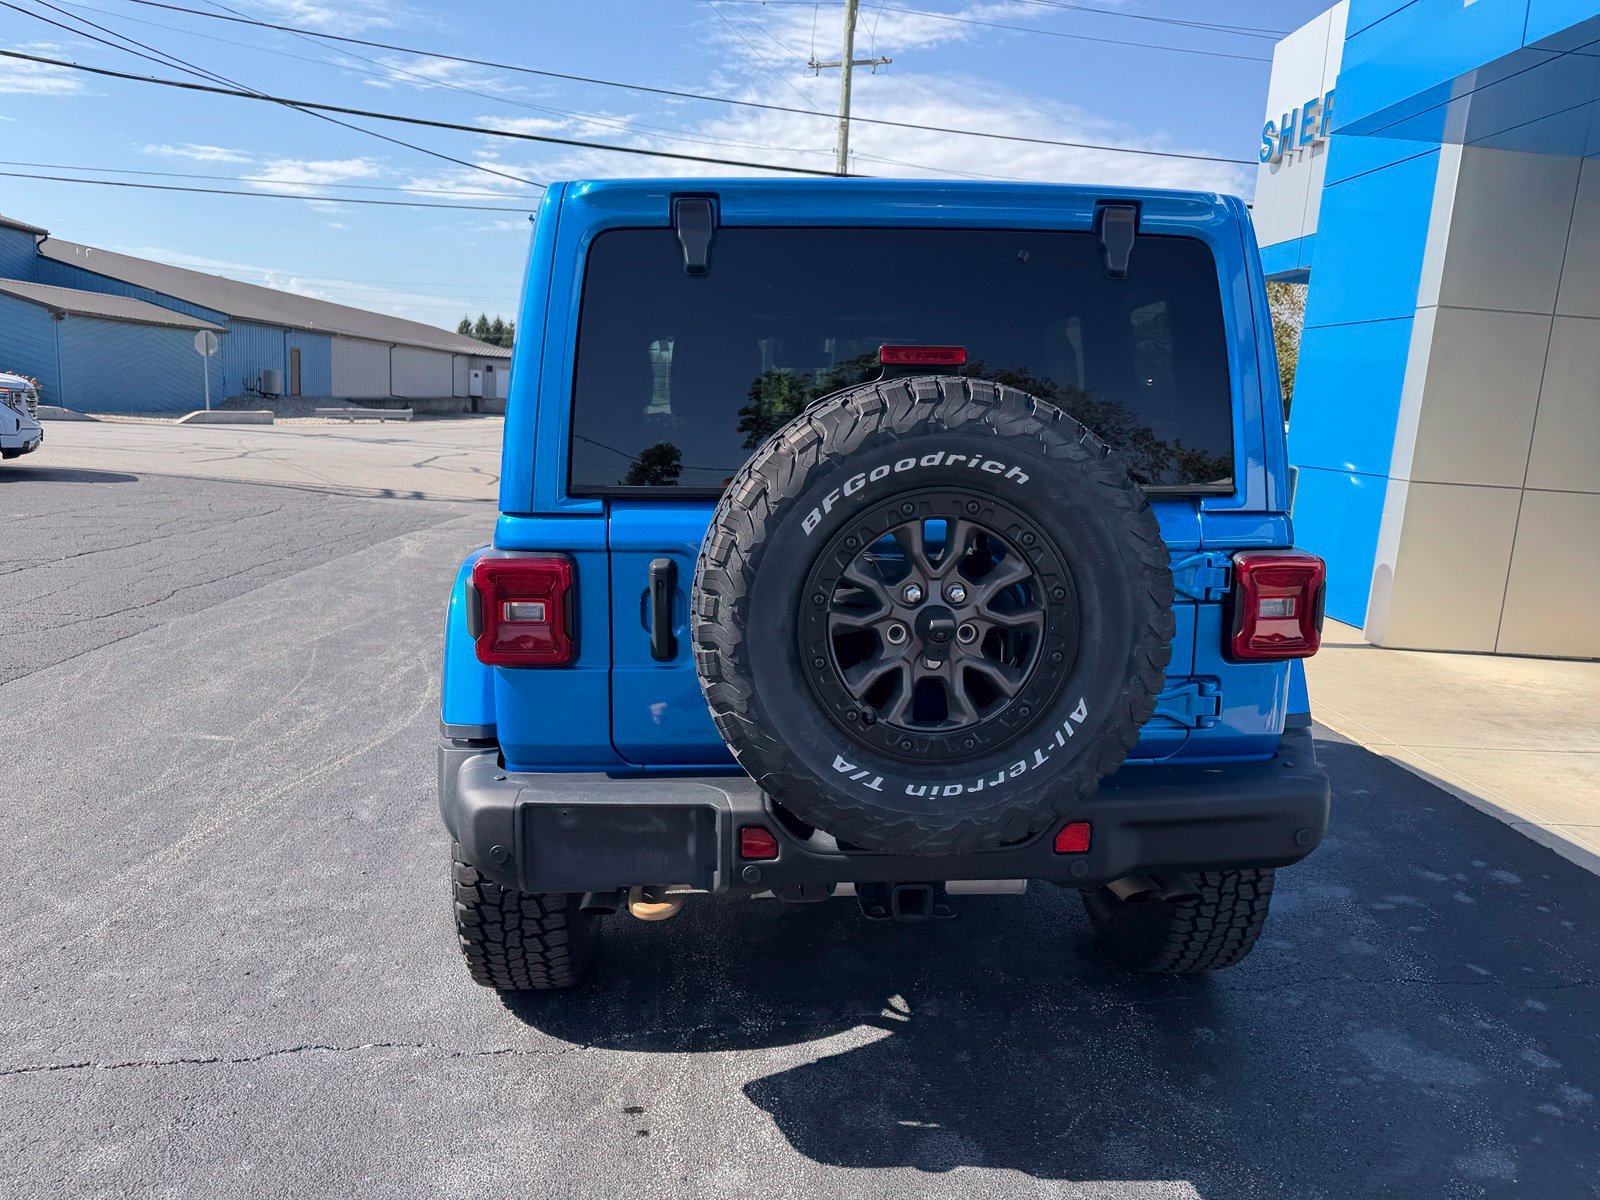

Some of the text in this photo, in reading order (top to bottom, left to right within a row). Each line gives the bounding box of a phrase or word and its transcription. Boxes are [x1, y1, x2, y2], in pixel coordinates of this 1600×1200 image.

[801, 451, 1030, 536] BFGoodrich
[832, 697, 1088, 799] All-Terrain T/A
